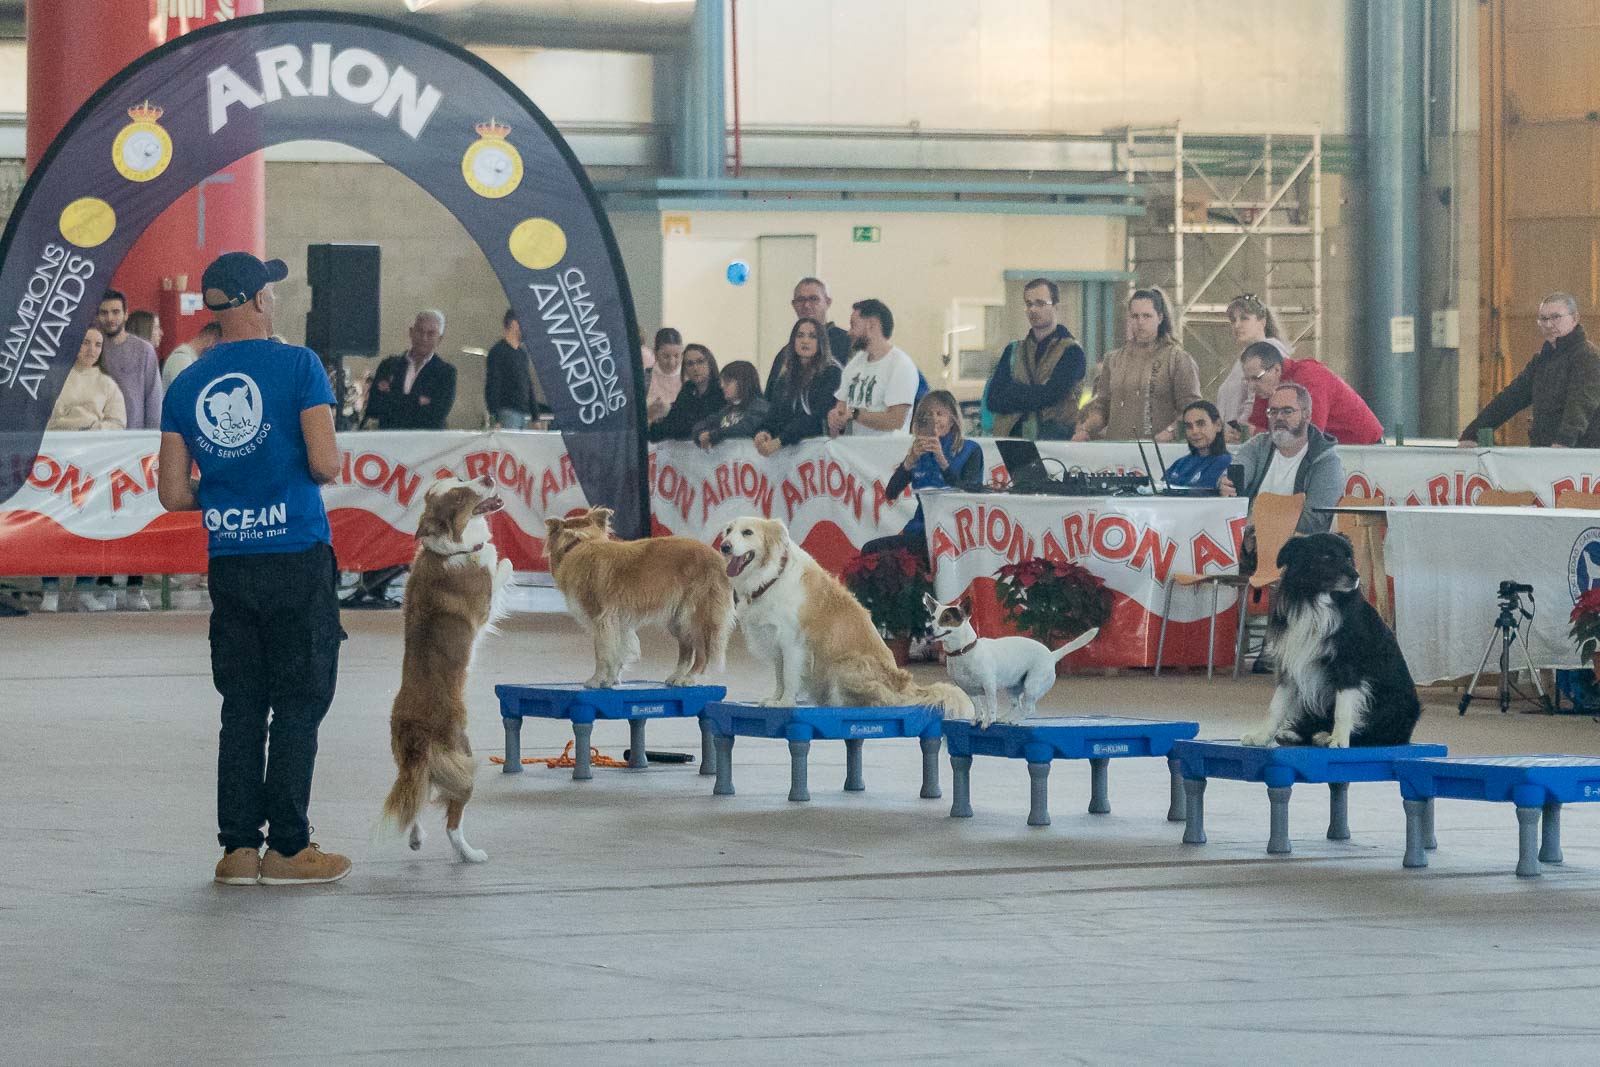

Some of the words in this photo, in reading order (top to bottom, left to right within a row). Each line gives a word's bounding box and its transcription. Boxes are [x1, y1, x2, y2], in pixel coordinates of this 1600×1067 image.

[207, 43, 442, 140] ARION
[18, 255, 95, 400] AWARDS
[528, 284, 606, 424] AWARDS
[564, 268, 627, 412] CHAMPIONS
[196, 436, 214, 454] FULL
[217, 442, 256, 458] SERVICES
[255, 422, 272, 445] DOG
[205, 502, 287, 531] OCEAN
[702, 462, 773, 528] ARION
[781, 459, 864, 522] ARION
[239, 529, 263, 541] pide
[266, 527, 288, 538] mar
[931, 505, 1035, 573] ARION
